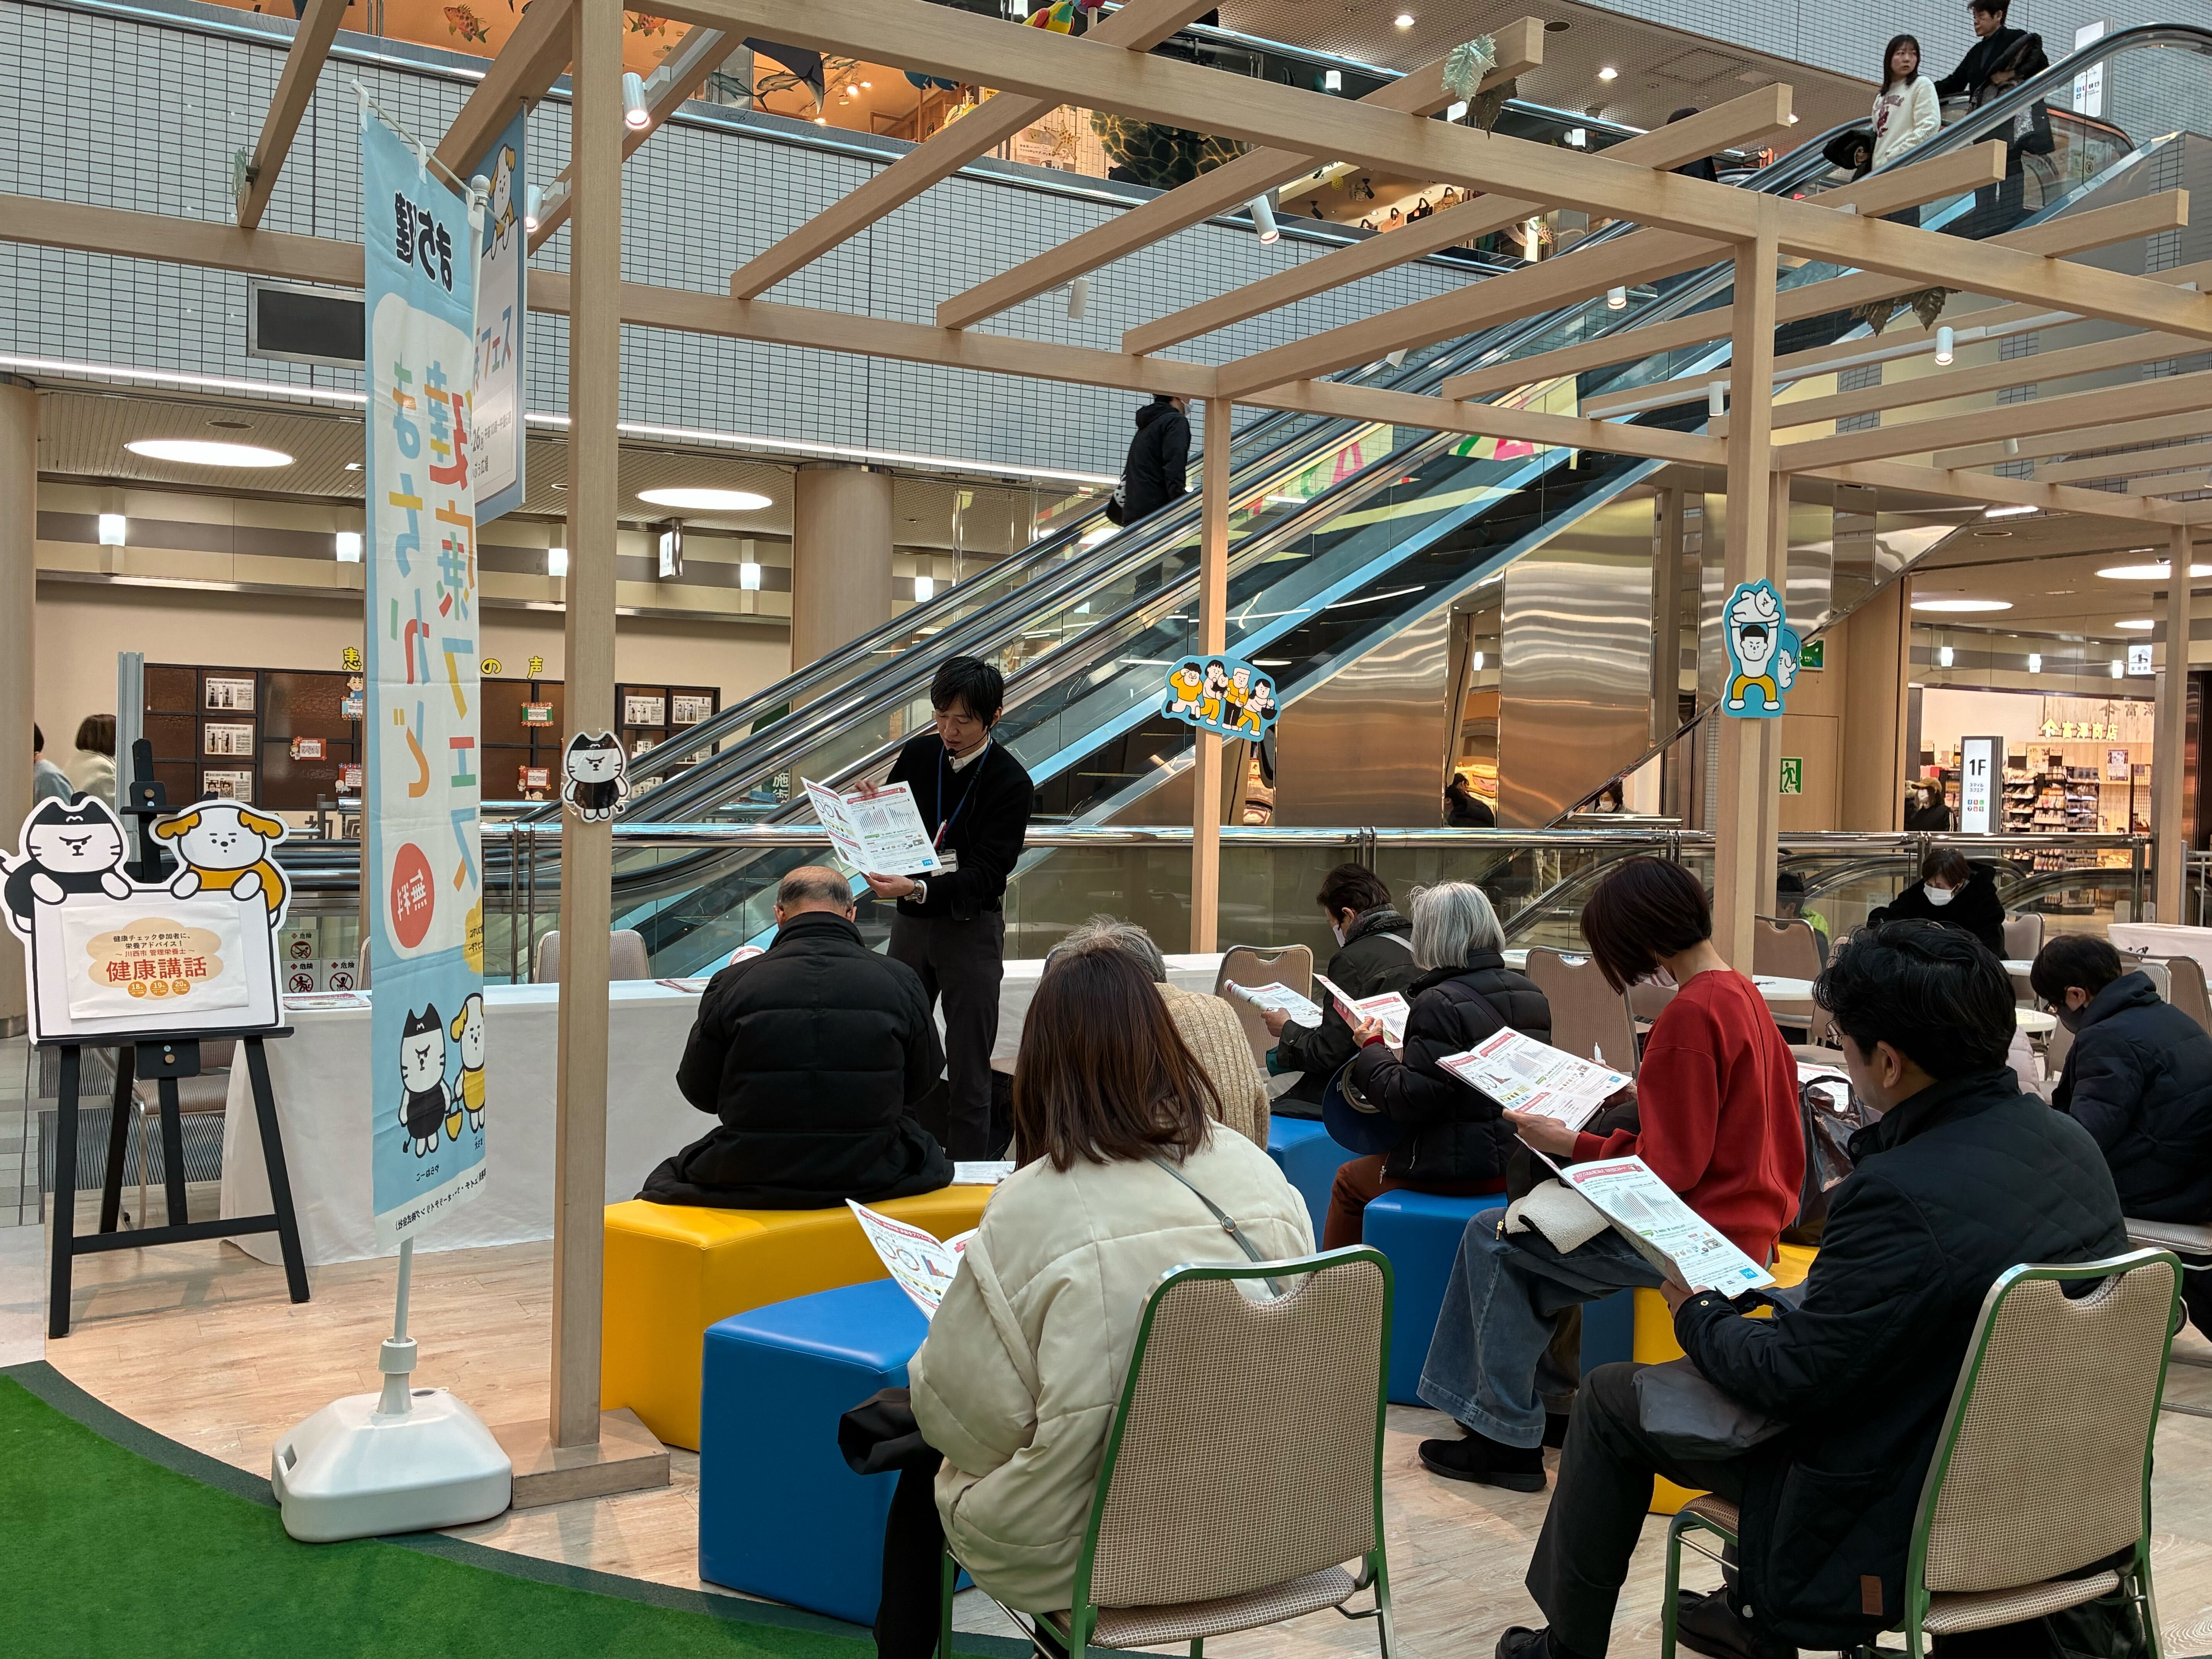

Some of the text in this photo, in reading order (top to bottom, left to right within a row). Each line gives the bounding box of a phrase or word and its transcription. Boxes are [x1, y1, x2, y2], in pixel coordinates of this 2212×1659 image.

[1969, 759, 1986, 776] 1F
[113, 933, 191, 942] 健康チェック参加者に、
[125, 940, 182, 949] 栄養アドバイス！
[106, 956, 207, 982] 健康講話
